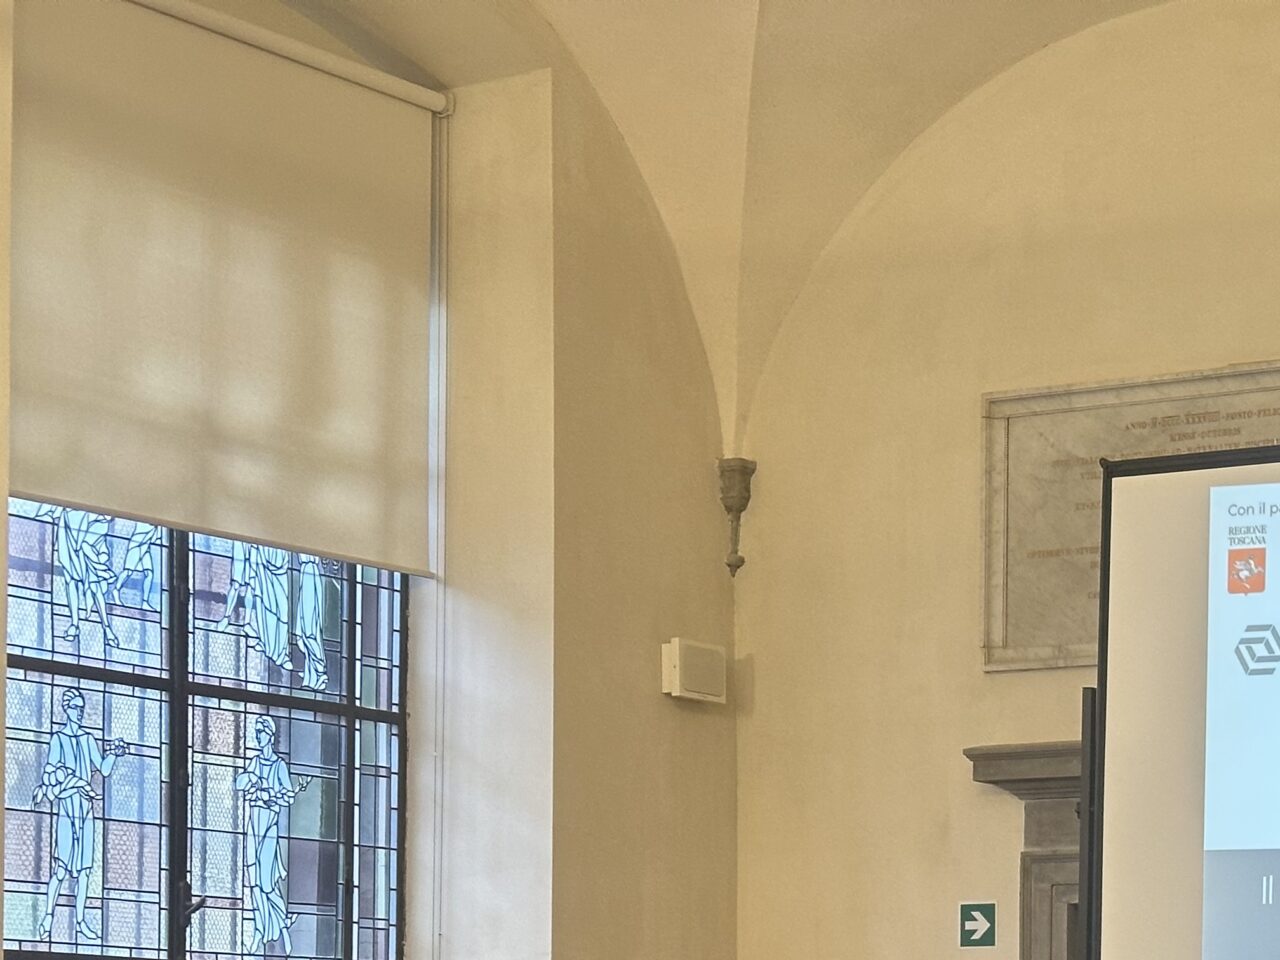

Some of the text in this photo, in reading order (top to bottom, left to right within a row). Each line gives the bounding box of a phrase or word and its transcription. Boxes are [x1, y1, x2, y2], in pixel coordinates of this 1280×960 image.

[1228, 504, 1255, 517] Con
[1259, 502, 1266, 515] il
[1228, 524, 1267, 536] REGIONE
[1228, 535, 1266, 546] TOSCANA
[1263, 875, 1273, 904] Il
